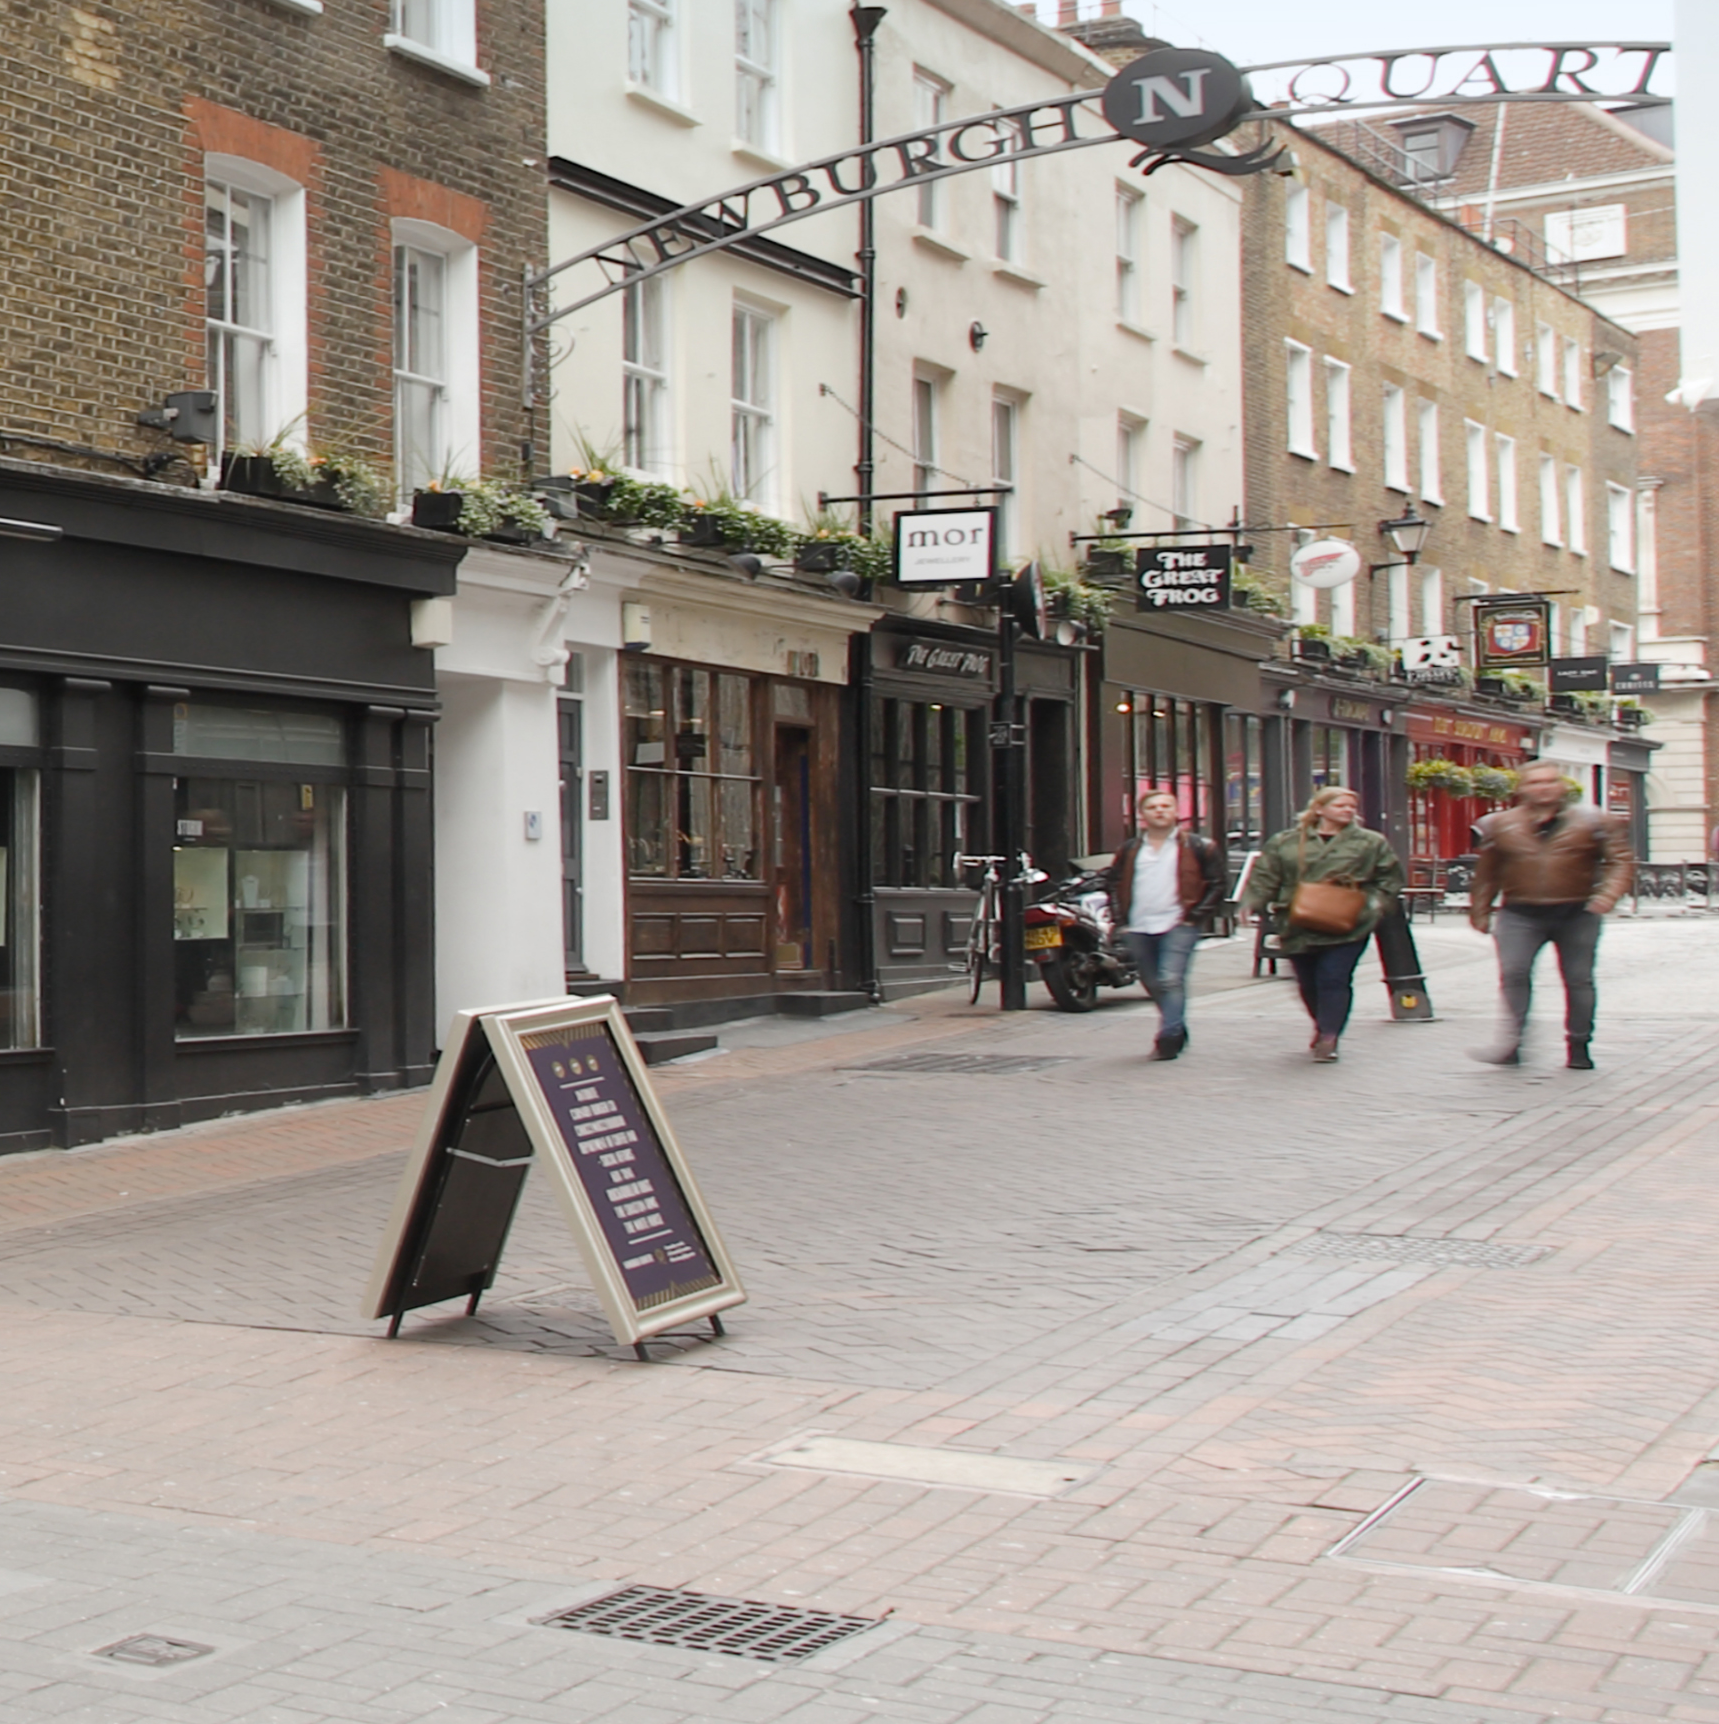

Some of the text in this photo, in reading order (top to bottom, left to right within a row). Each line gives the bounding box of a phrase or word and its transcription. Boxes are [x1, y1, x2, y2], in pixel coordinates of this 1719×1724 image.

[1288, 47, 1673, 105] QUART
[1131, 68, 1212, 126] N
[588, 105, 1089, 286] NEWBURGH
[907, 527, 984, 548] mor
[1155, 551, 1209, 570] THE
[1140, 567, 1226, 589] GREAT
[1145, 586, 1222, 607] FROG
